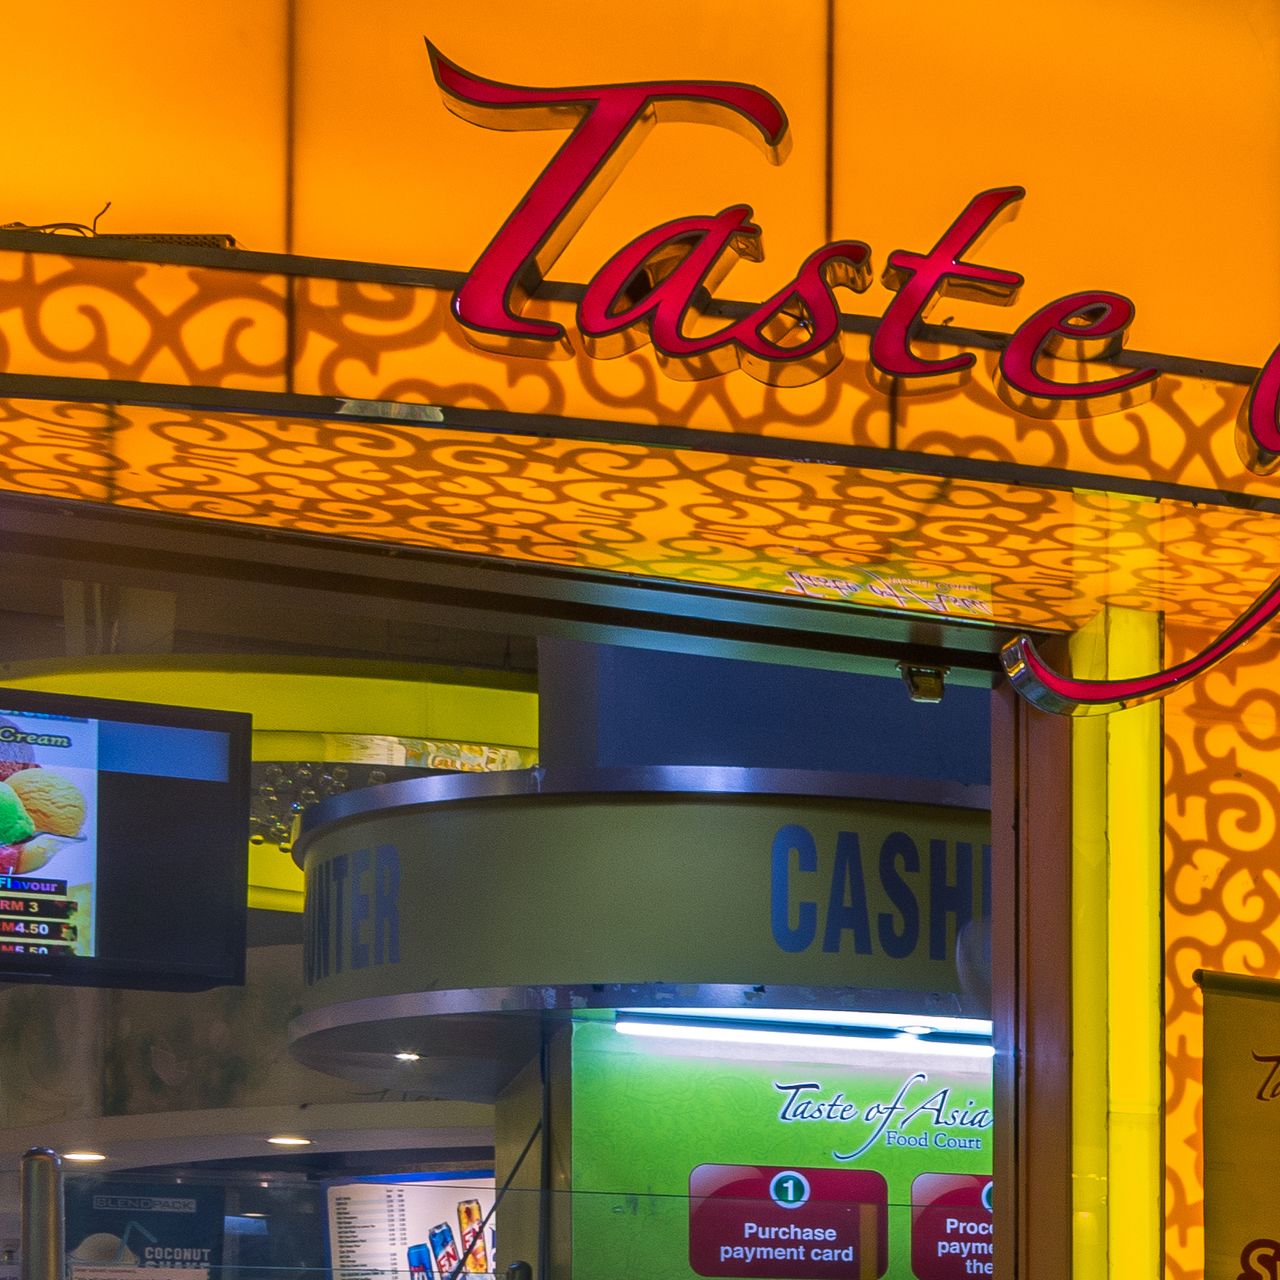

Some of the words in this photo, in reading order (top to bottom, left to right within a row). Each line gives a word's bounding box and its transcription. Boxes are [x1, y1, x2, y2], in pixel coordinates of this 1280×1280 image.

[424, 35, 1161, 408] Taste
[28, 901, 39, 912] 3
[774, 1081, 857, 1122] Taste
[832, 1072, 927, 1161] of
[900, 1087, 992, 1129] Asia
[886, 1130, 929, 1148] Food
[934, 1131, 982, 1150] Court
[782, 1180, 796, 1200] 1
[744, 1222, 837, 1242] Purchase
[145, 1247, 211, 1260] COCONUT
[720, 1245, 807, 1263] payment
[810, 1245, 854, 1262] card
